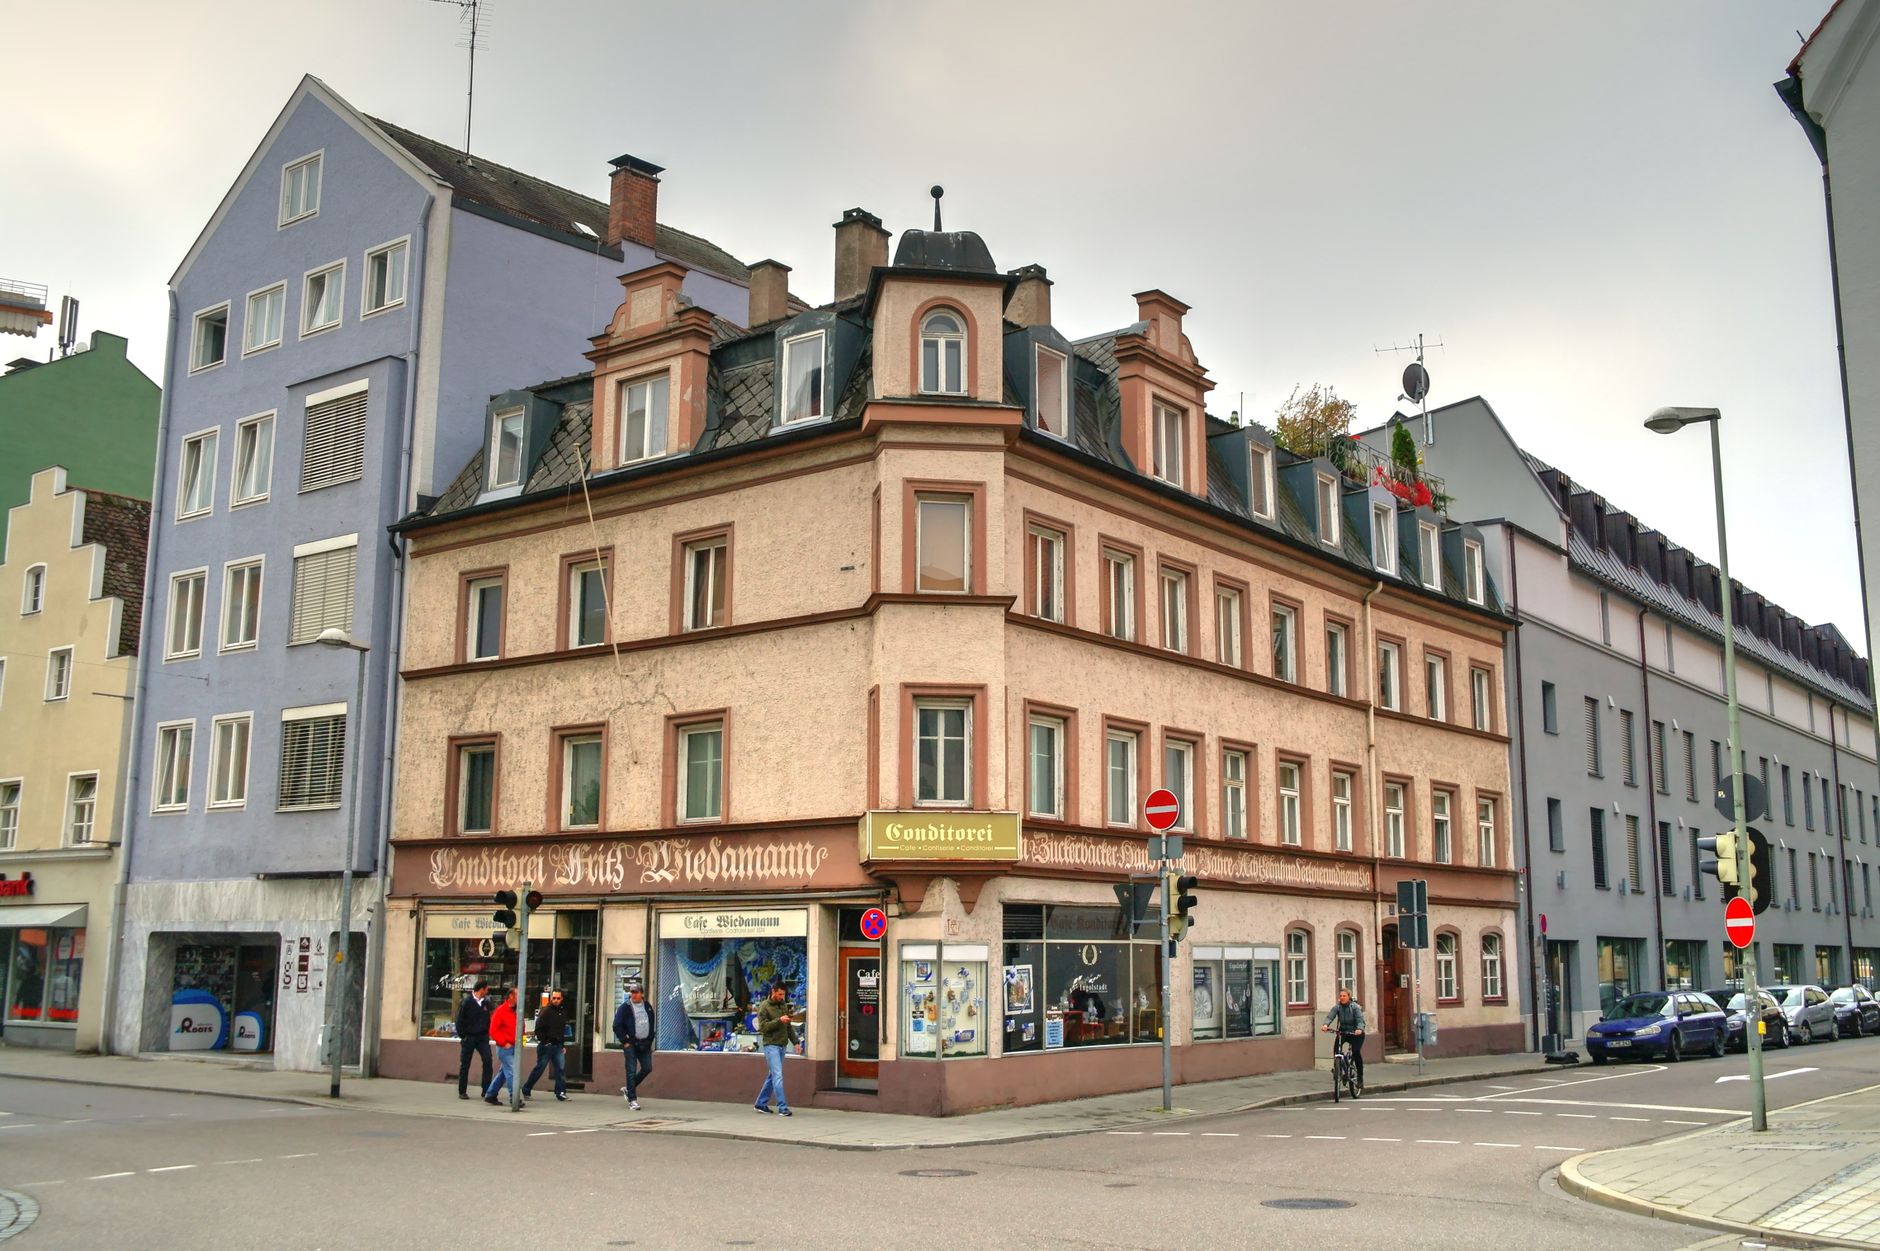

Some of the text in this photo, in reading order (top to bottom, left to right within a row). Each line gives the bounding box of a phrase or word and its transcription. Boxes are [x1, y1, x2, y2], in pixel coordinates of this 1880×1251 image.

[885, 823, 993, 842] Conditorei
[429, 837, 829, 890] Conditorei Fritz Wiedamann
[451, 918, 506, 930] Cafe Wieda
[684, 915, 780, 930] Cafe Wiedamann
[857, 969, 880, 978] Cafe
